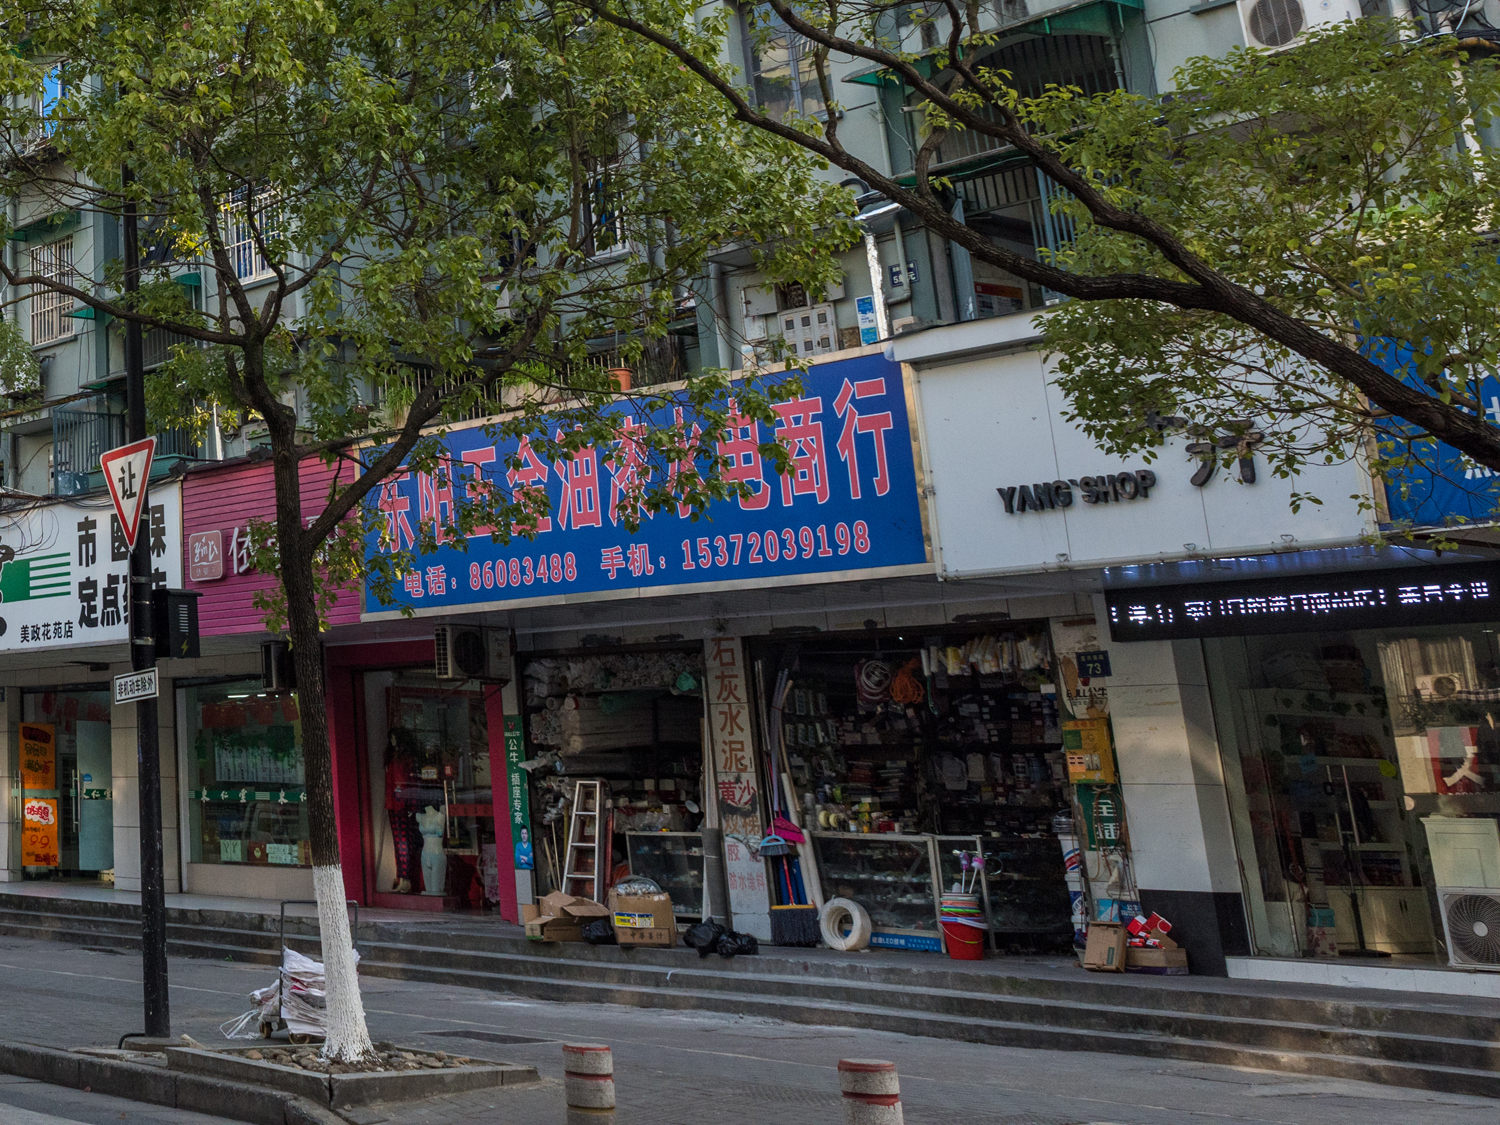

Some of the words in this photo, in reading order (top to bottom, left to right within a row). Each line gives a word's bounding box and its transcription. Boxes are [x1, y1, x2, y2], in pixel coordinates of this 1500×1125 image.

[118, 461, 137, 500] 让
[19, 619, 74, 644] 美政花苑店
[1086, 663, 1102, 675] 73
[117, 675, 154, 697] 非机动车除外
